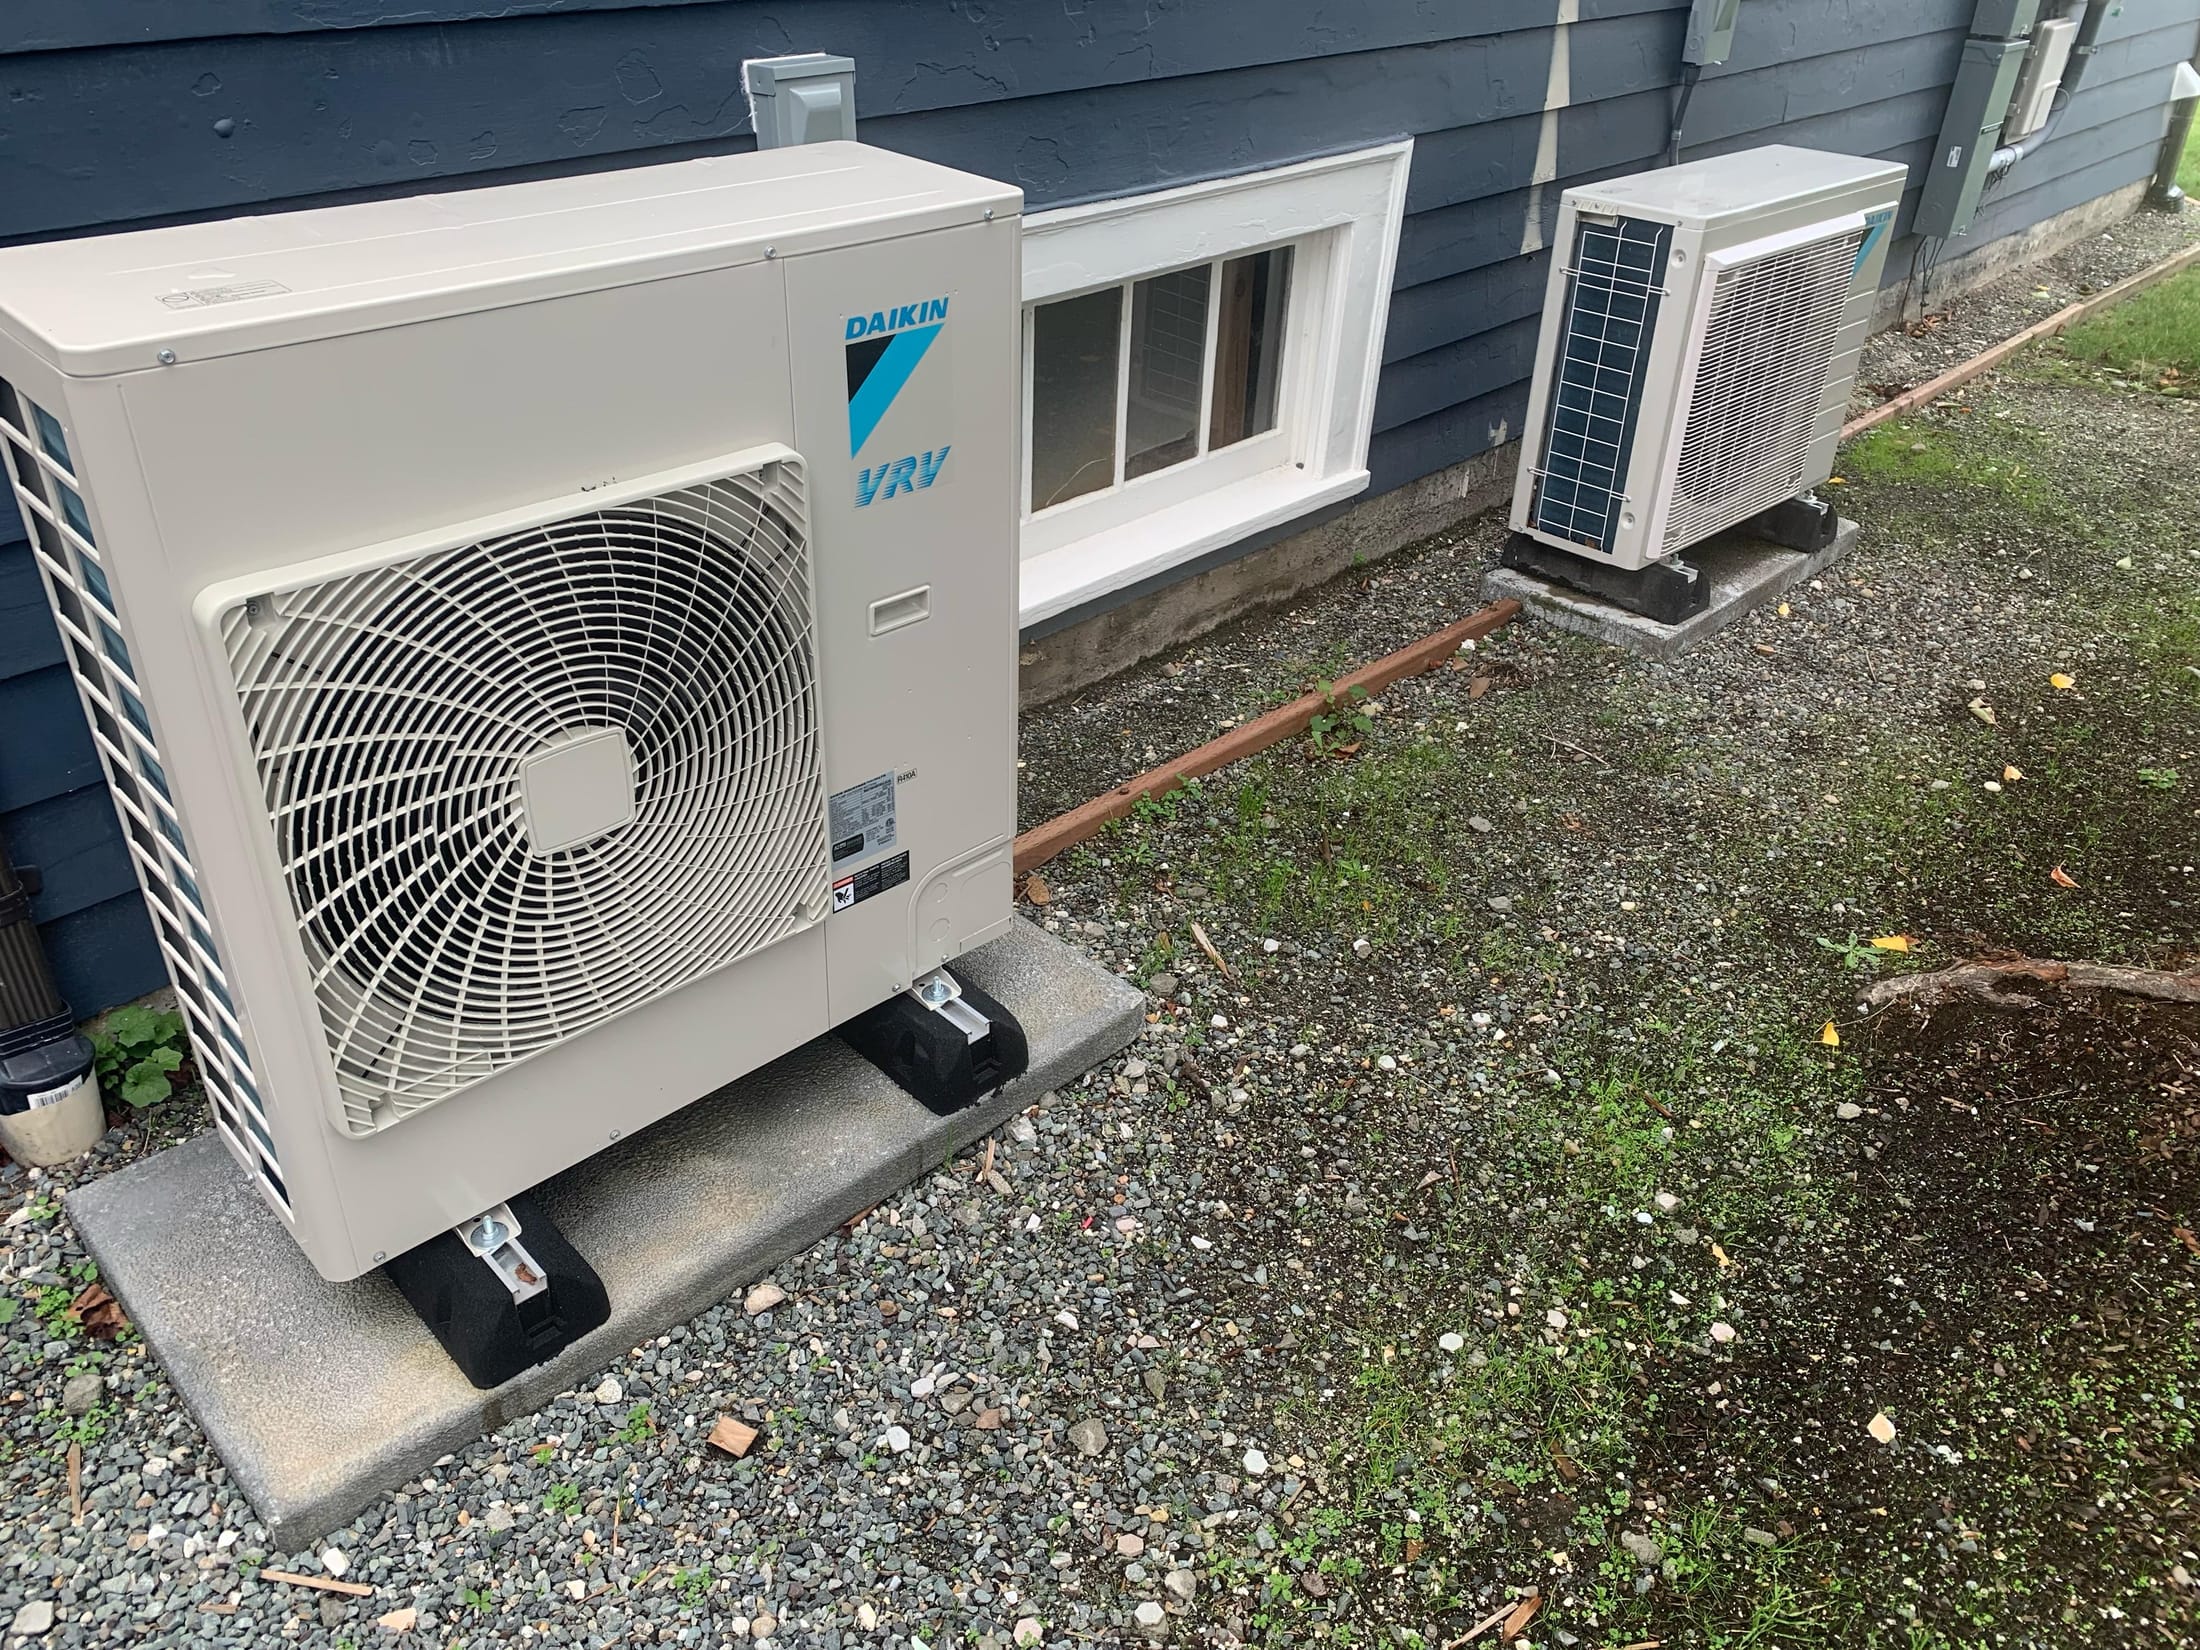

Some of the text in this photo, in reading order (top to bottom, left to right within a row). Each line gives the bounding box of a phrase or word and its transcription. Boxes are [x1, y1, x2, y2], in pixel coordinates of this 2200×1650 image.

[845, 297, 949, 340] DAIKIN
[855, 445, 952, 508] VRV
[897, 770, 916, 783] R410A
